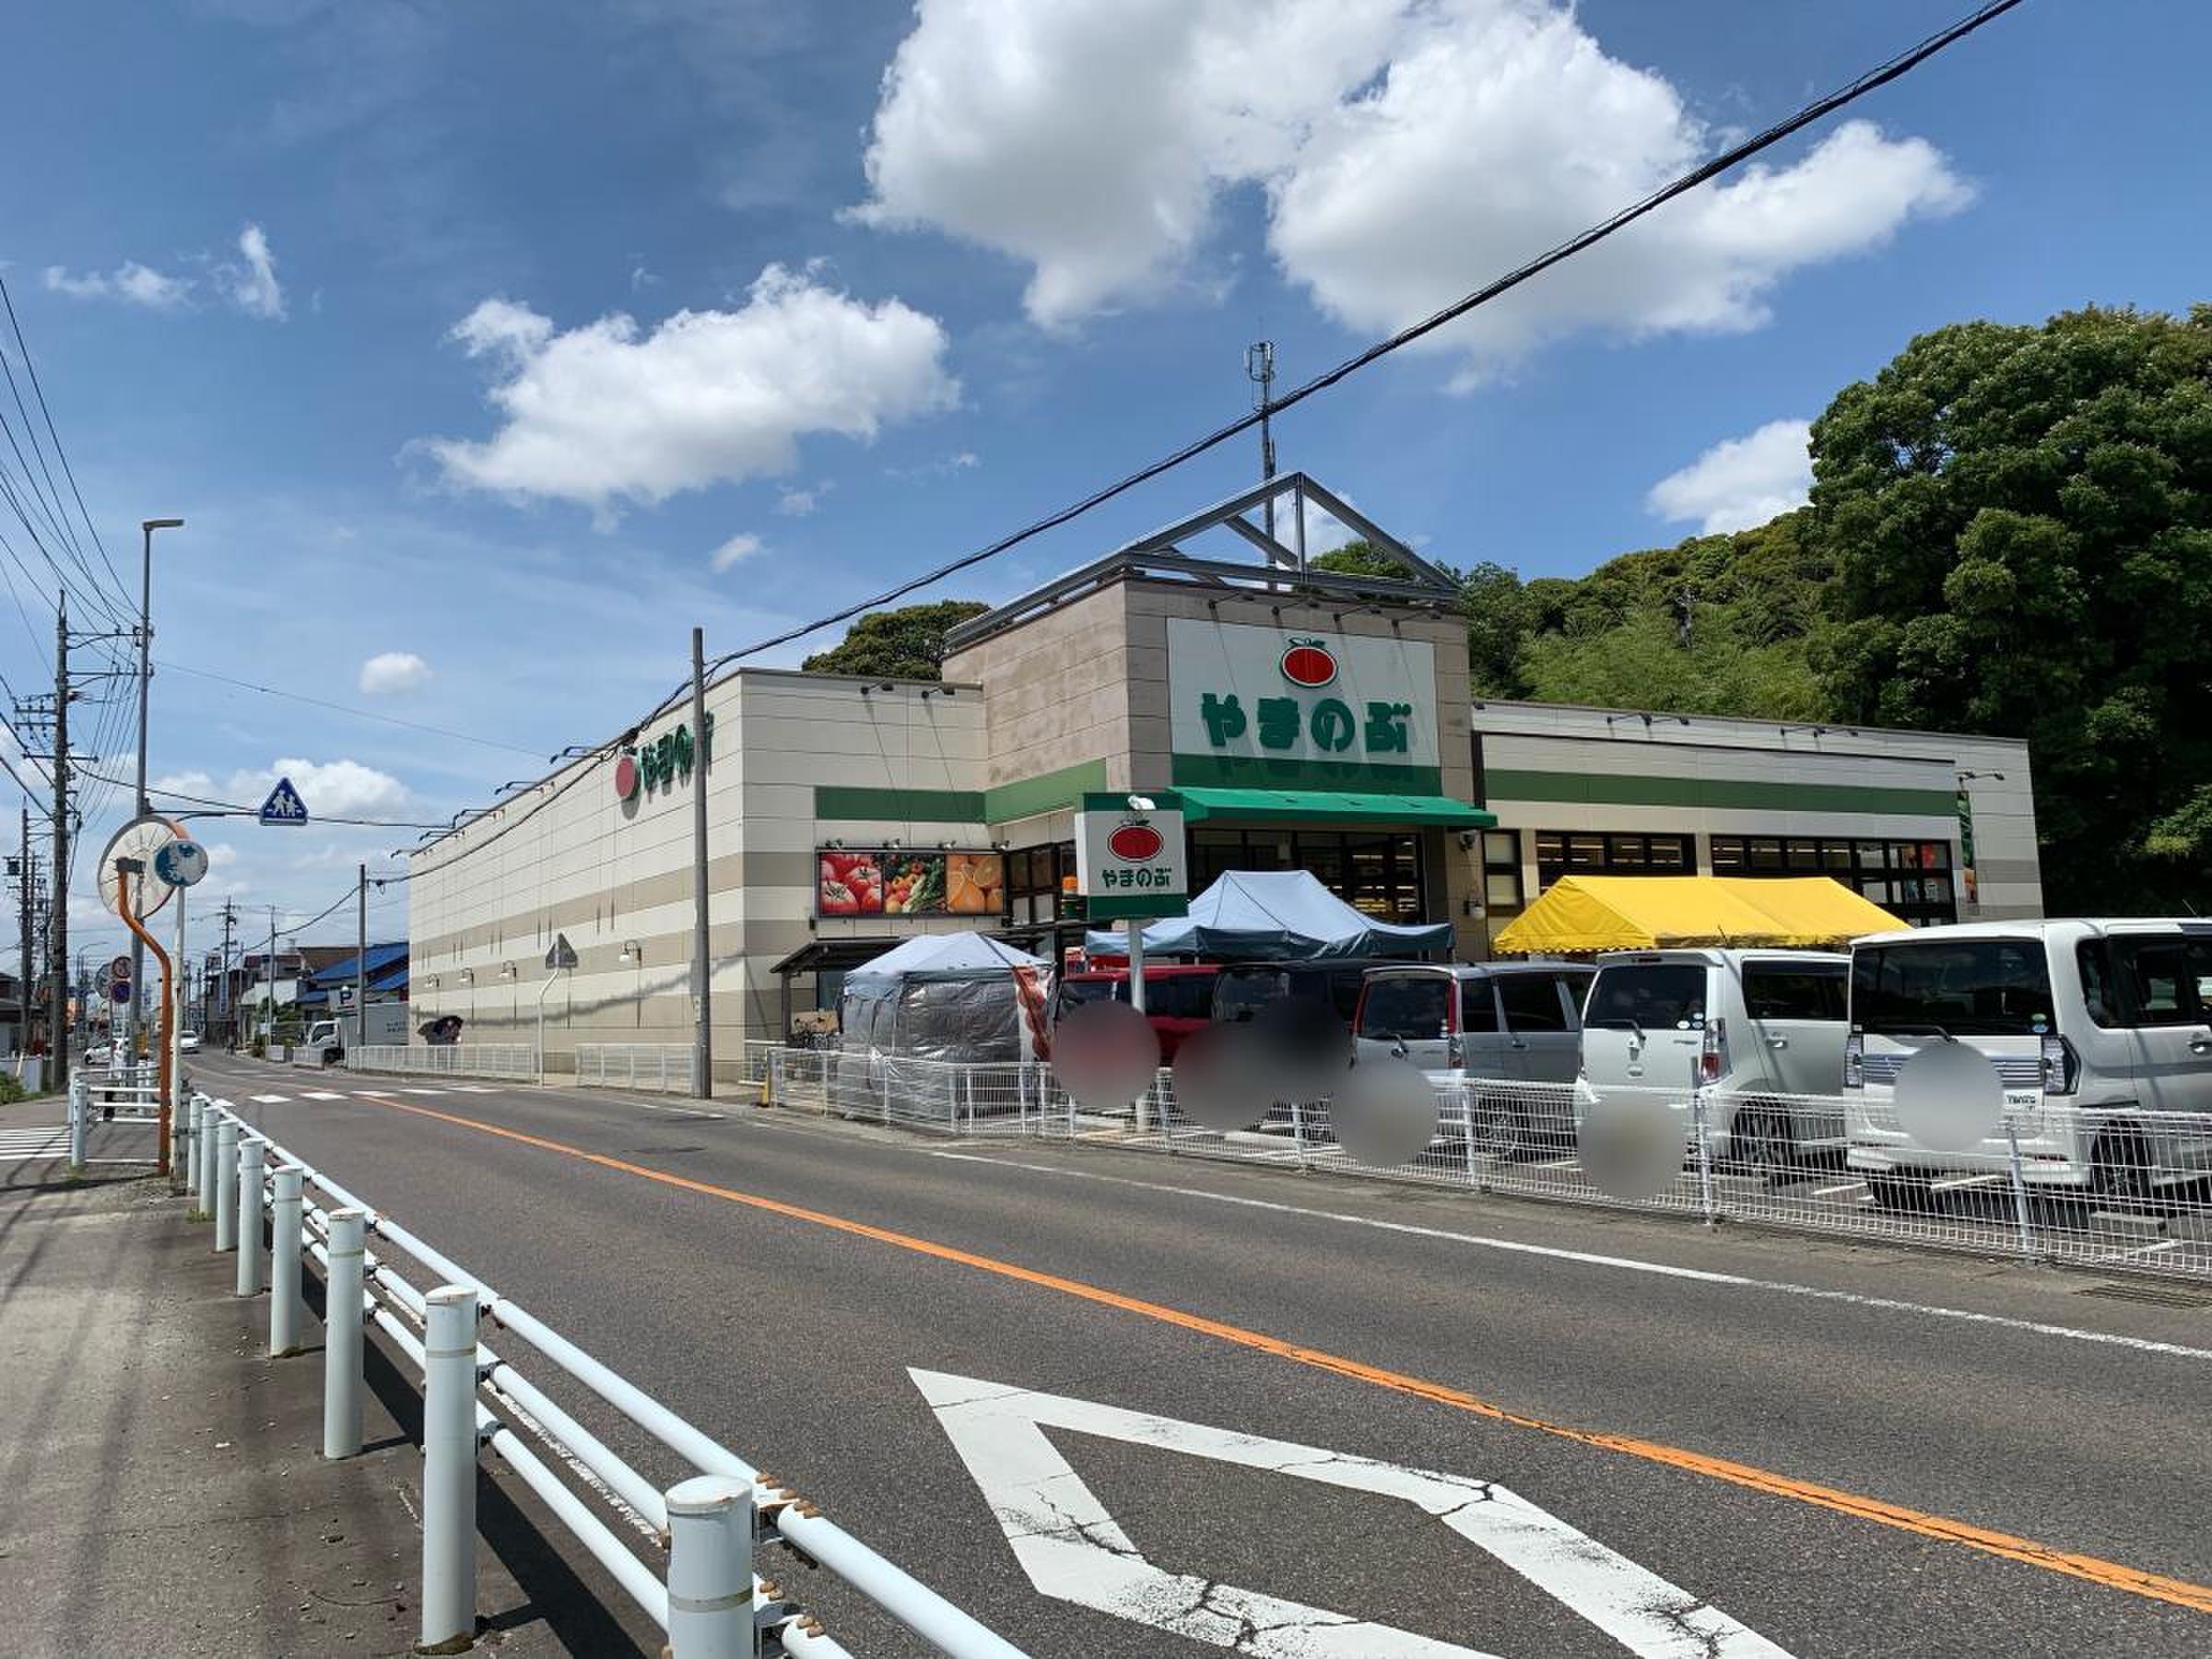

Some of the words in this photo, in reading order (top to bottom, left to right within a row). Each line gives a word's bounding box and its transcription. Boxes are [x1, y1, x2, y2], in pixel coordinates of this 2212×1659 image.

[1201, 692, 1412, 752] やまのぶ
[1101, 867, 1171, 888] やまのぶ
